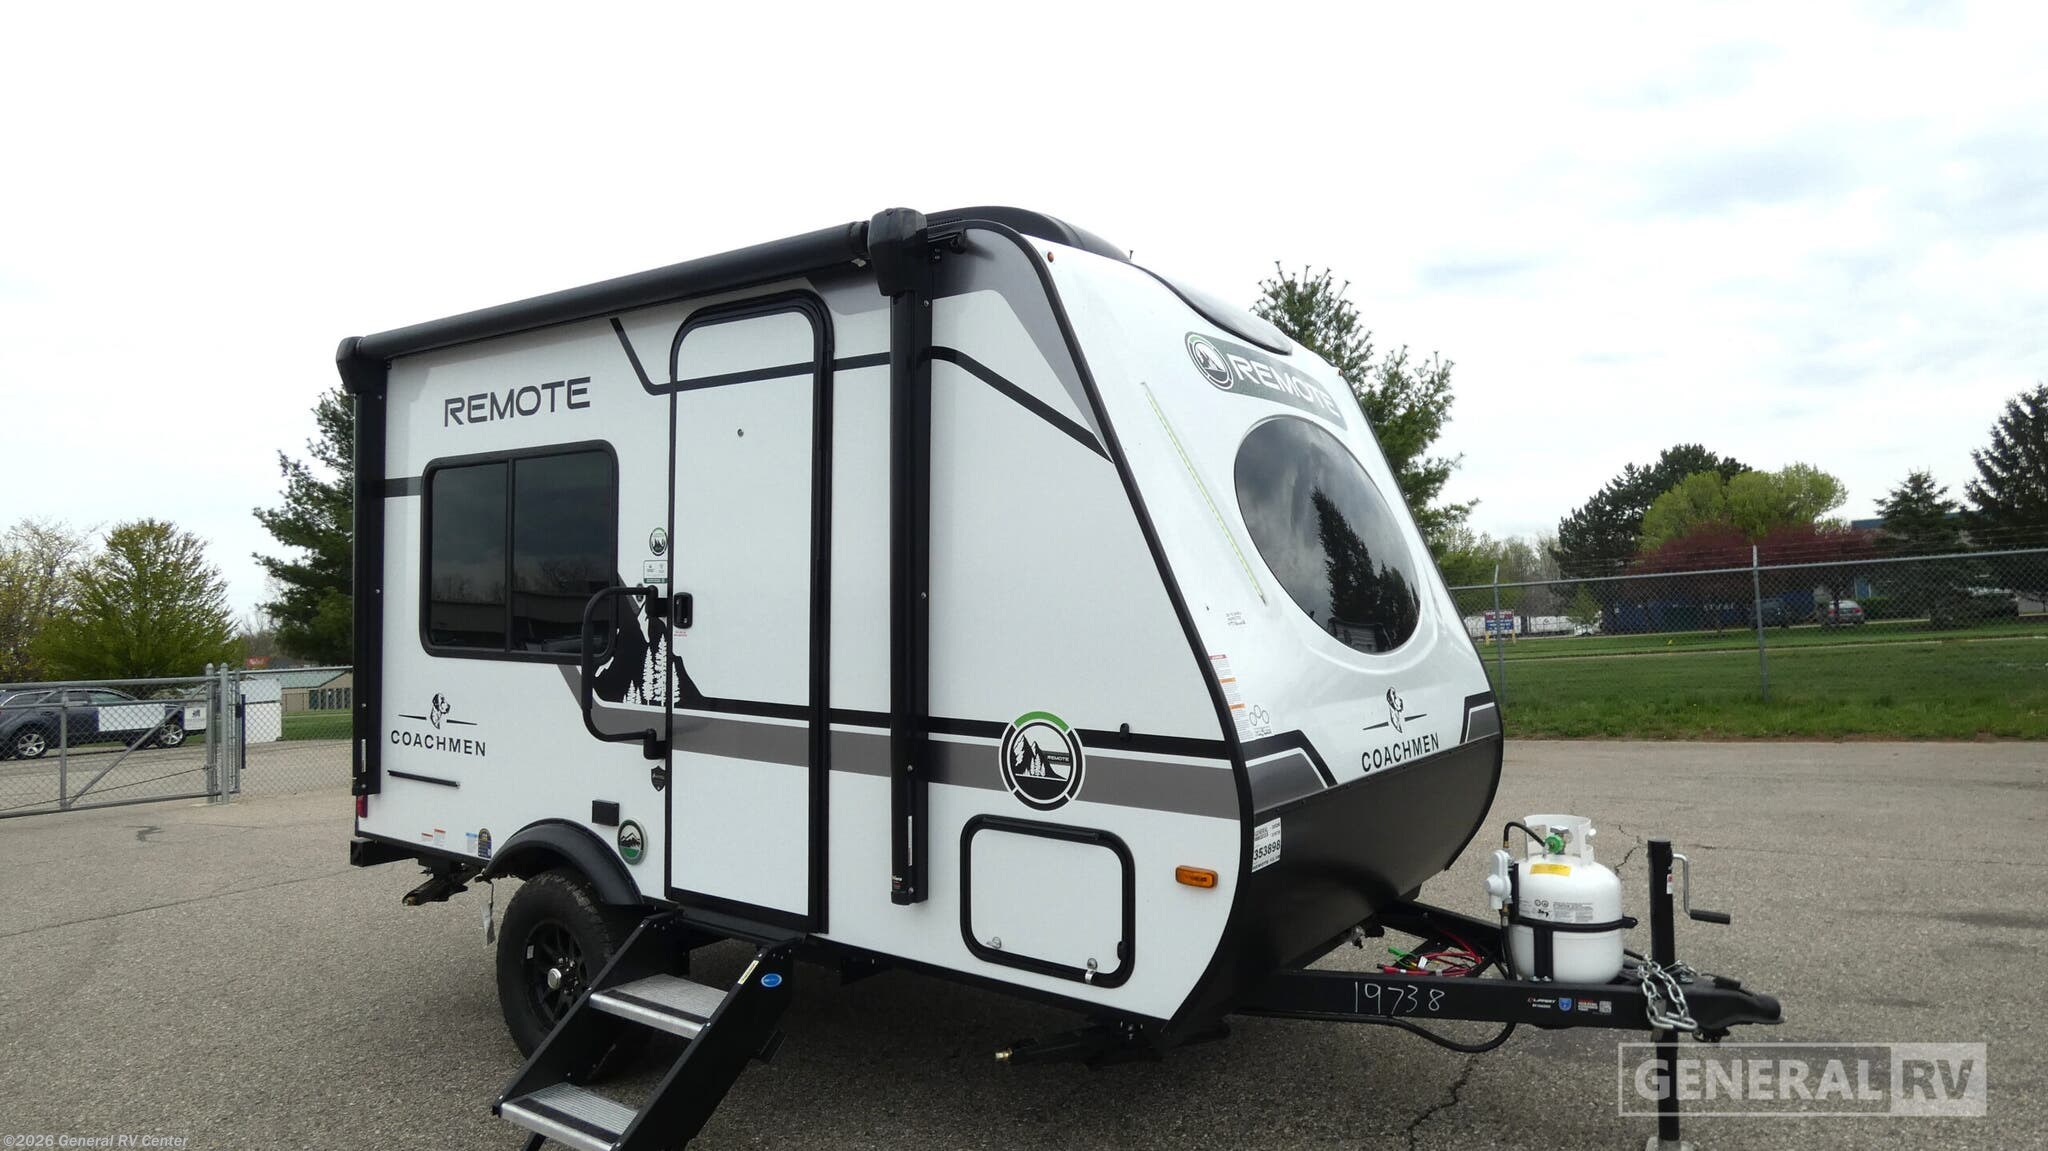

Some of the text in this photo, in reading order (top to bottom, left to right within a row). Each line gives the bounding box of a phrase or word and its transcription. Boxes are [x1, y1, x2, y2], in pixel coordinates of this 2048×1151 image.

[444, 376, 591, 427] REMOTE
[1226, 353, 1341, 418] REMOTE
[390, 730, 486, 756] COACHMEN
[1361, 732, 1440, 772] COACHMEN
[1354, 981, 1445, 1015] 19738
